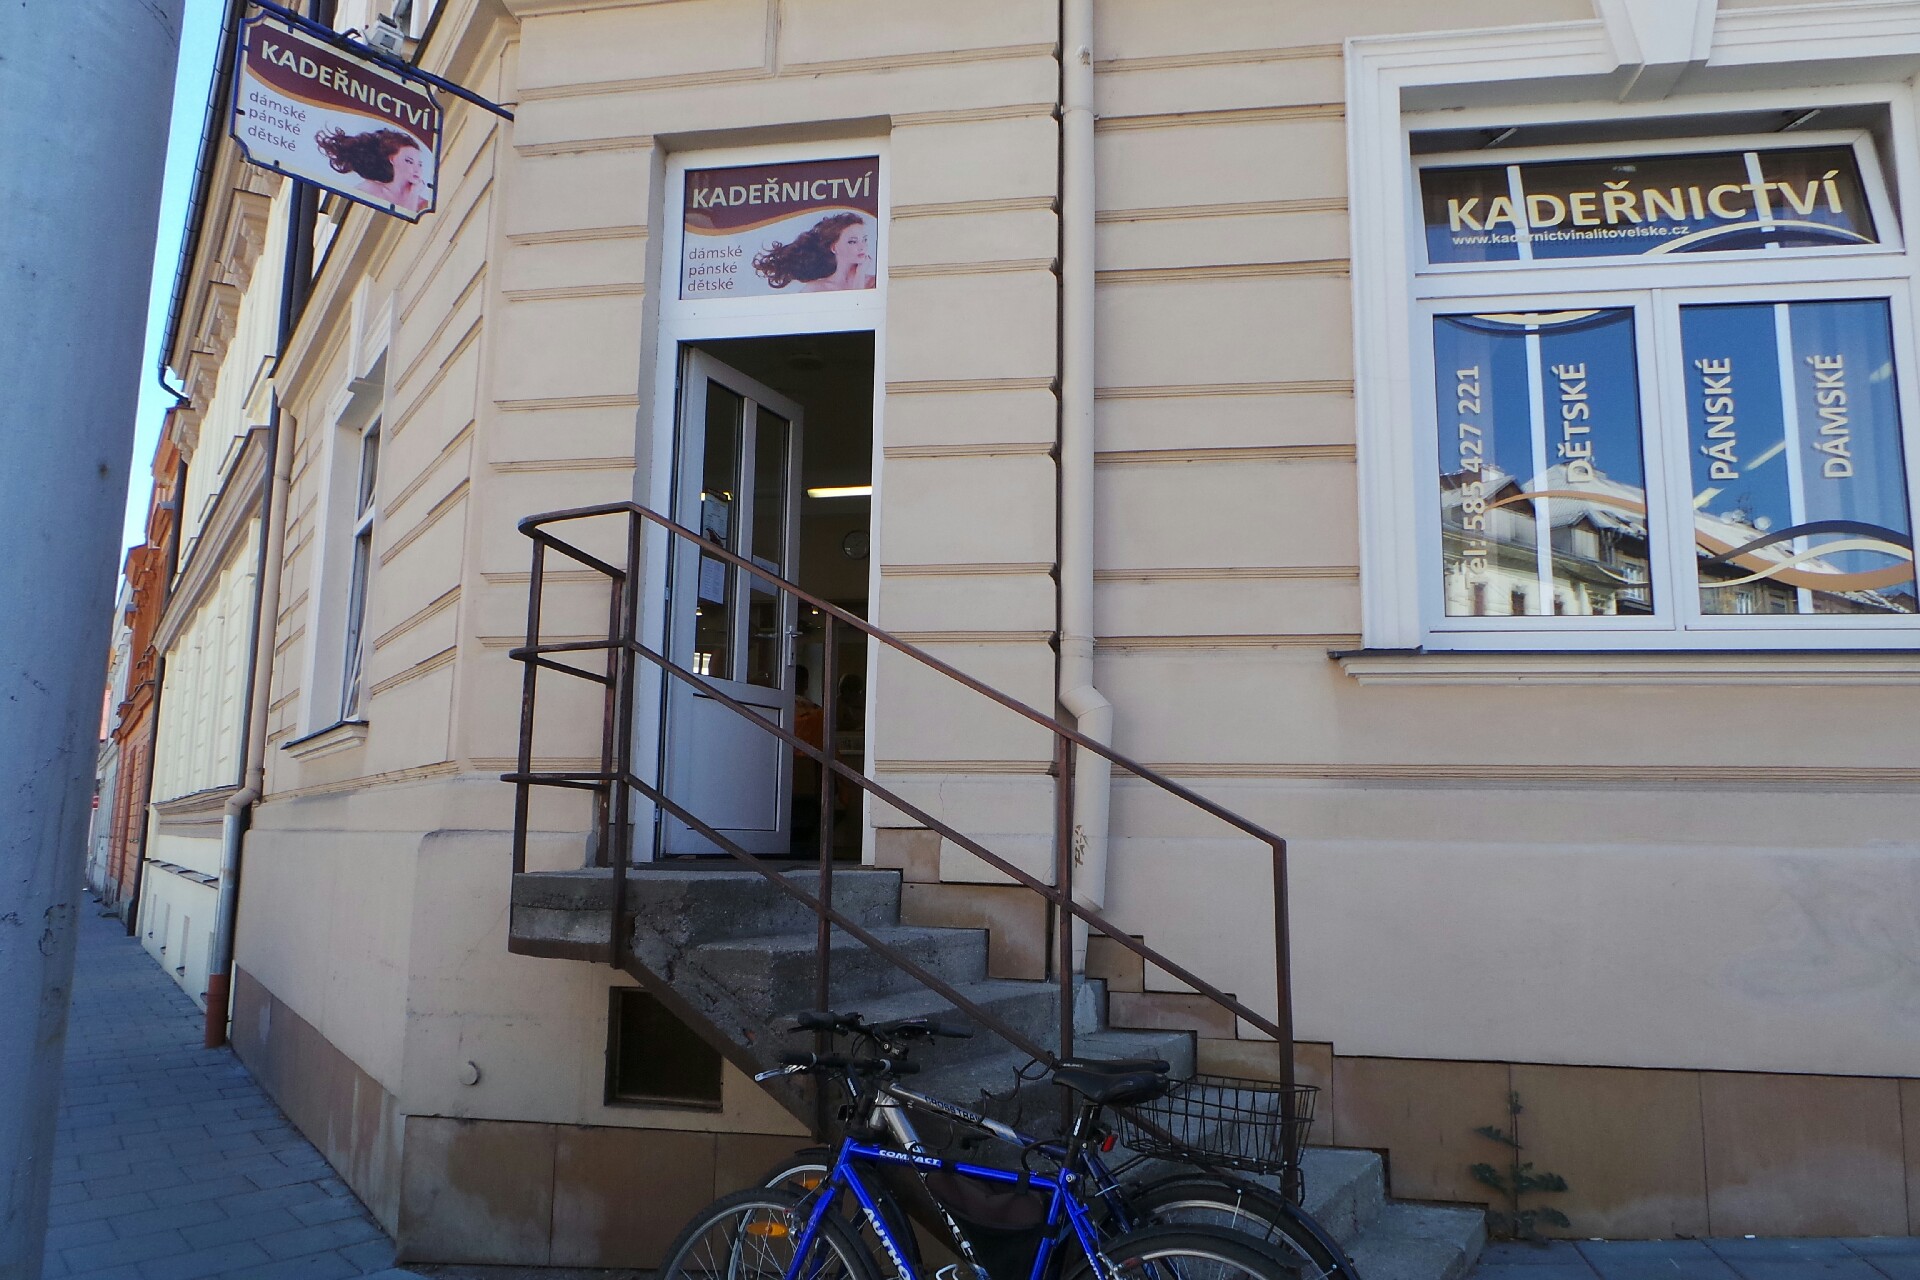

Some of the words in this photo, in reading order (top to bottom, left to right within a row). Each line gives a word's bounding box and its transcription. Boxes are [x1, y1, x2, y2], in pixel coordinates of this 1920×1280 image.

[249, 91, 306, 122] dámské
[261, 39, 430, 131] KADEŘNICTVÍ
[247, 125, 296, 152] dětské
[249, 108, 301, 136] pánské
[692, 171, 873, 209] KADEŘNICTVÍ
[1447, 169, 1843, 232] KADEŘNICTVÍ
[688, 245, 743, 260] dámské
[1452, 225, 1690, 245] www.kadrnictvinalitovelske.cz
[687, 278, 734, 292] dětské
[688, 262, 738, 278] pánské
[1456, 365, 1481, 415] 221
[1552, 362, 1594, 484] DĚTSKÉ
[1694, 357, 1739, 480] PÁNSKÉ
[1806, 354, 1853, 479] DÁMSKÉ
[1459, 423, 1483, 473] 427
[1462, 480, 1487, 531] 585
